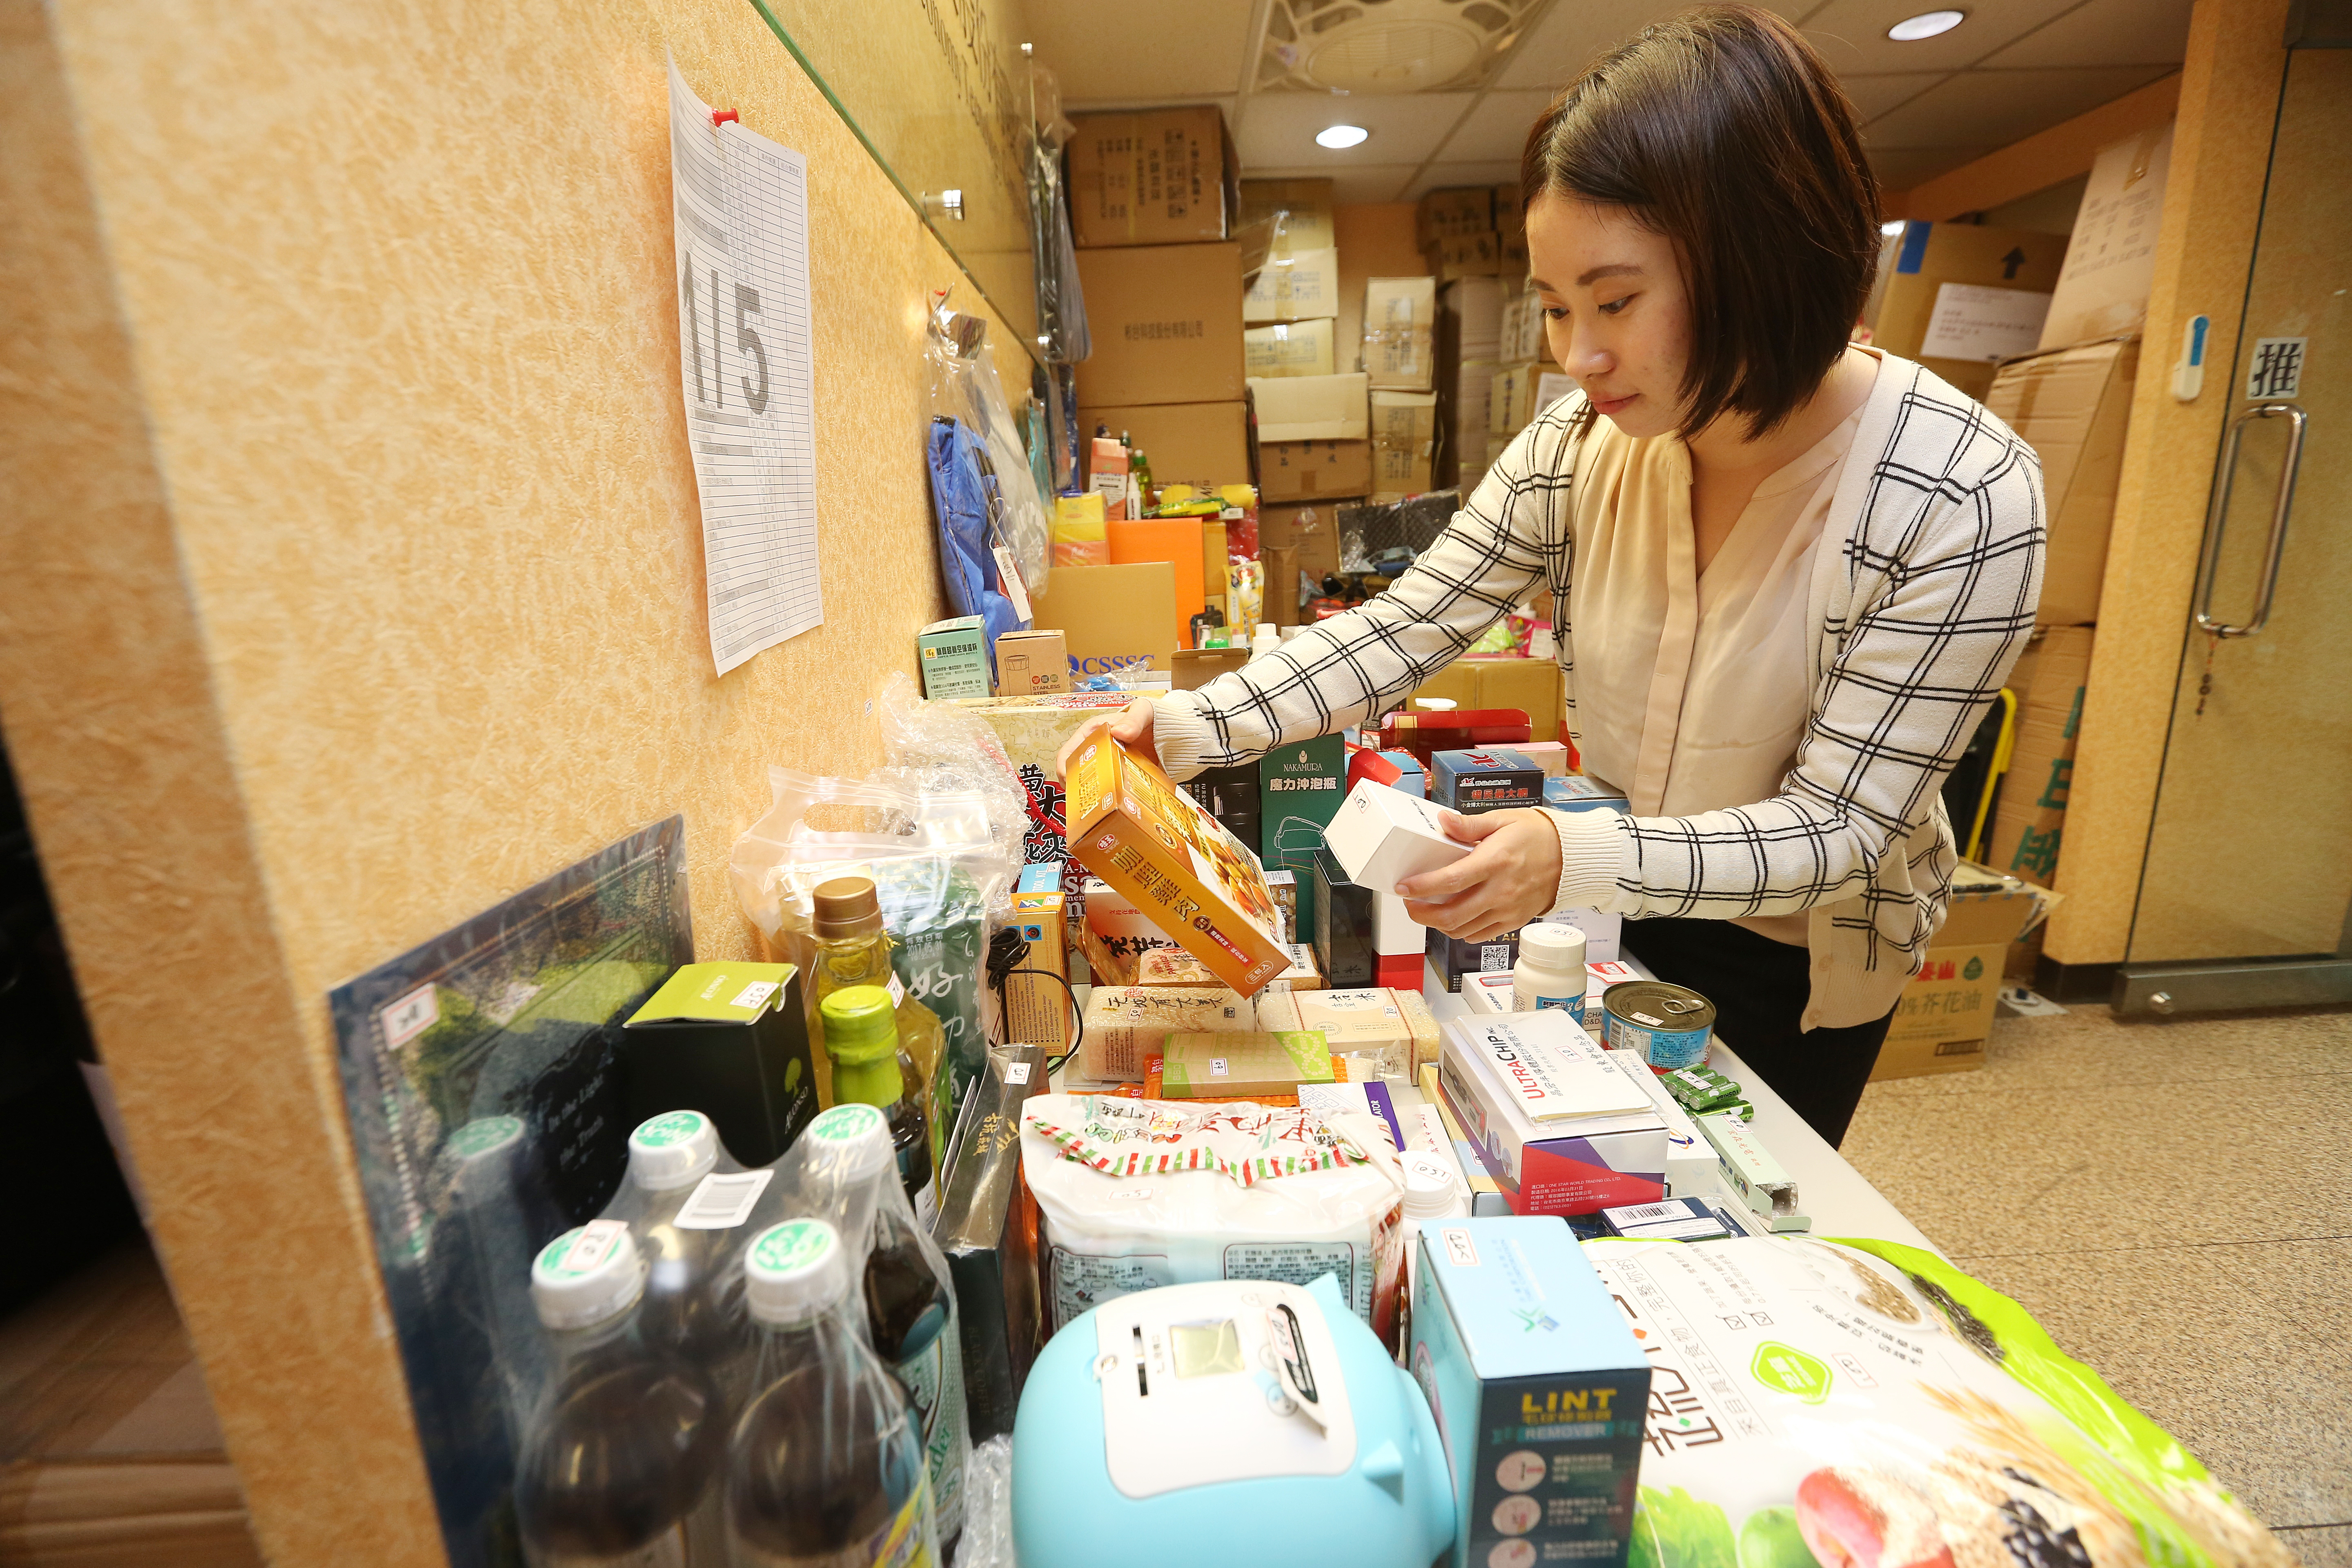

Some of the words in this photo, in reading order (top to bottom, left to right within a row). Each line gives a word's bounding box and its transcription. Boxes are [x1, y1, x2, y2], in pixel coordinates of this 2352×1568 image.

[2252, 342, 2302, 398] 推
[1083, 654, 1154, 674] CSSSC
[1283, 763, 1323, 772] NAKAMURA
[1270, 777, 1337, 791] 魔力沖泡瓶
[1471, 788, 1528, 800] 權民最大網
[1035, 870, 1047, 878] KIT
[1032, 879, 1045, 892] TOOL
[1109, 845, 1200, 922] 咖哩雞肉
[905, 932, 943, 945] 有效日期
[1162, 955, 1176, 976] PAPAGO!
[1247, 963, 1268, 978] 三包入
[1487, 1036, 1545, 1099] ULTRACHIP
[1717, 1089, 1739, 1101] TOSHIBA
[785, 1086, 809, 1135] ALONSO
[1521, 1388, 1617, 1413] LINT
[1524, 1423, 1608, 1439] REMOVER
